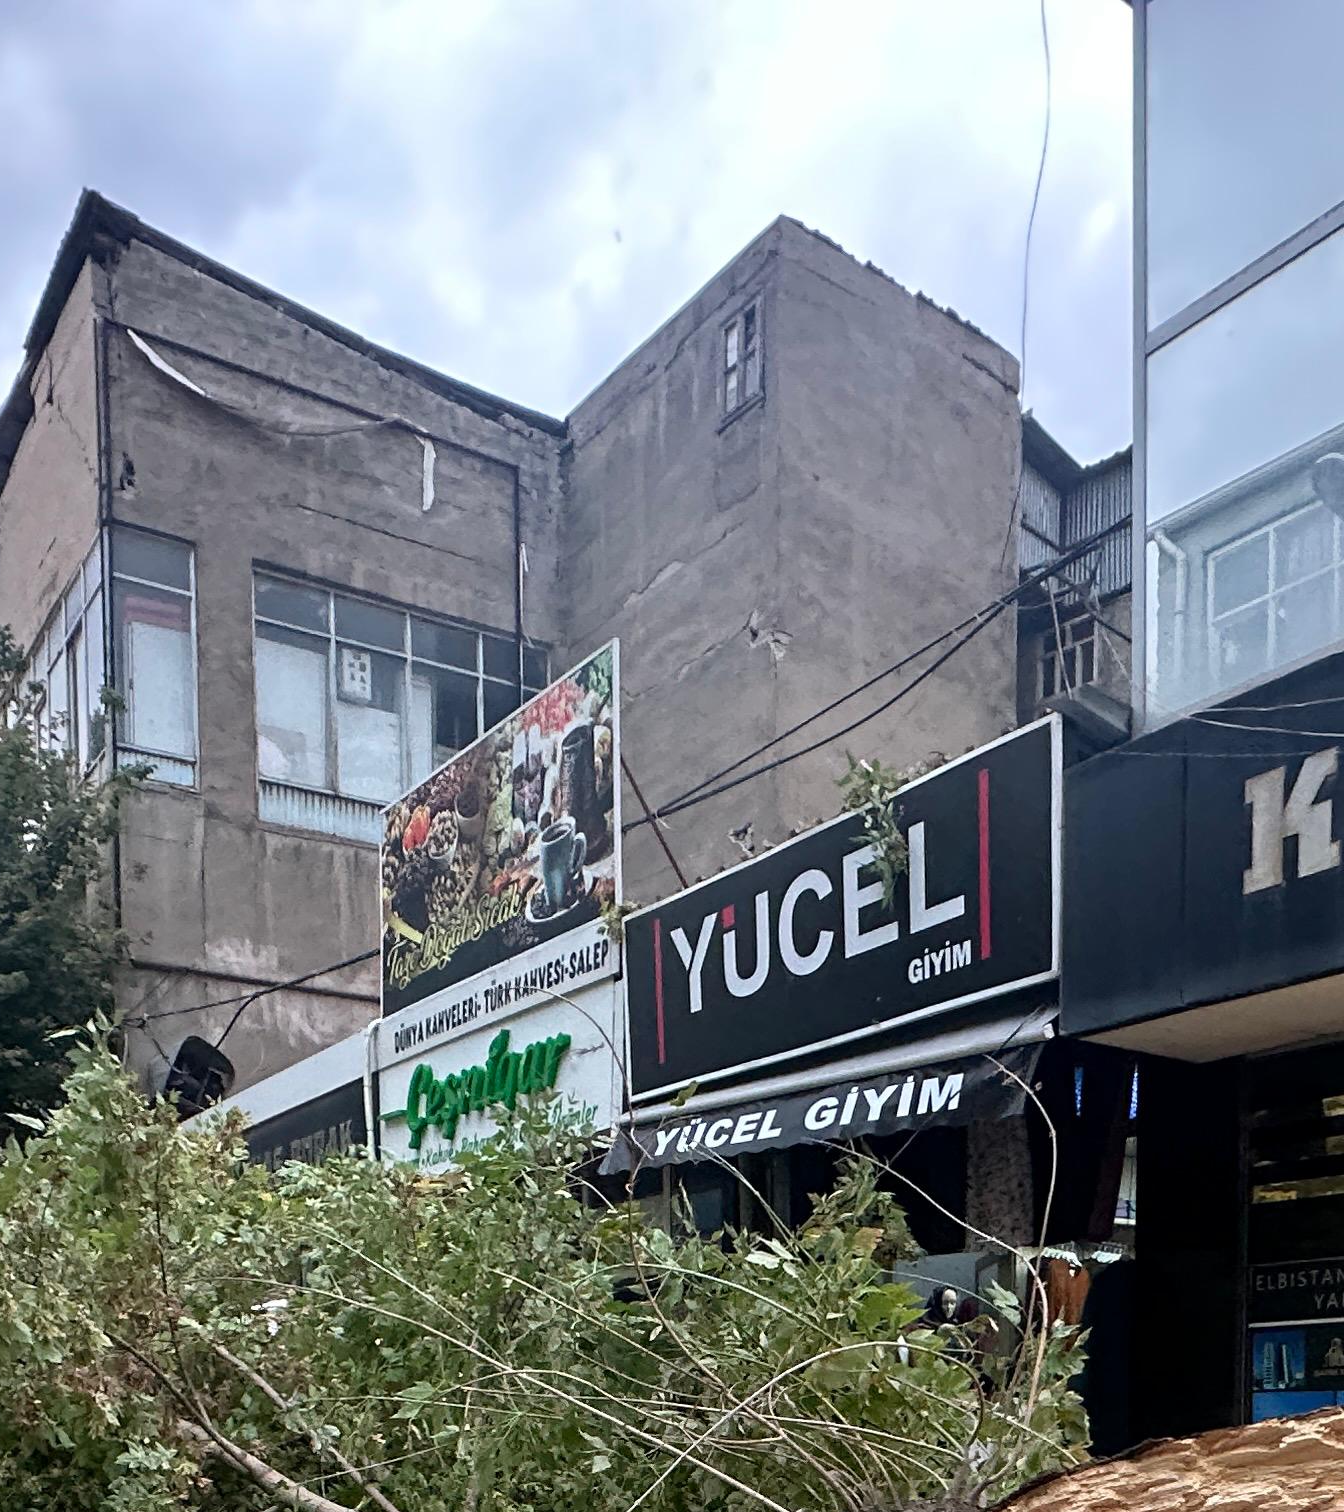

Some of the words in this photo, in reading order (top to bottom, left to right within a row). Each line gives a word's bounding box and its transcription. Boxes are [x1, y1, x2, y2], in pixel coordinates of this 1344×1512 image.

[670, 821, 965, 1013] YÜCEL
[908, 939, 972, 985] GİYİM
[393, 1022, 424, 1054] DÜNYA
[483, 979, 512, 1014] TÜRK
[654, 1109, 782, 1157] YÜCEL
[804, 1072, 965, 1132] GİYİM
